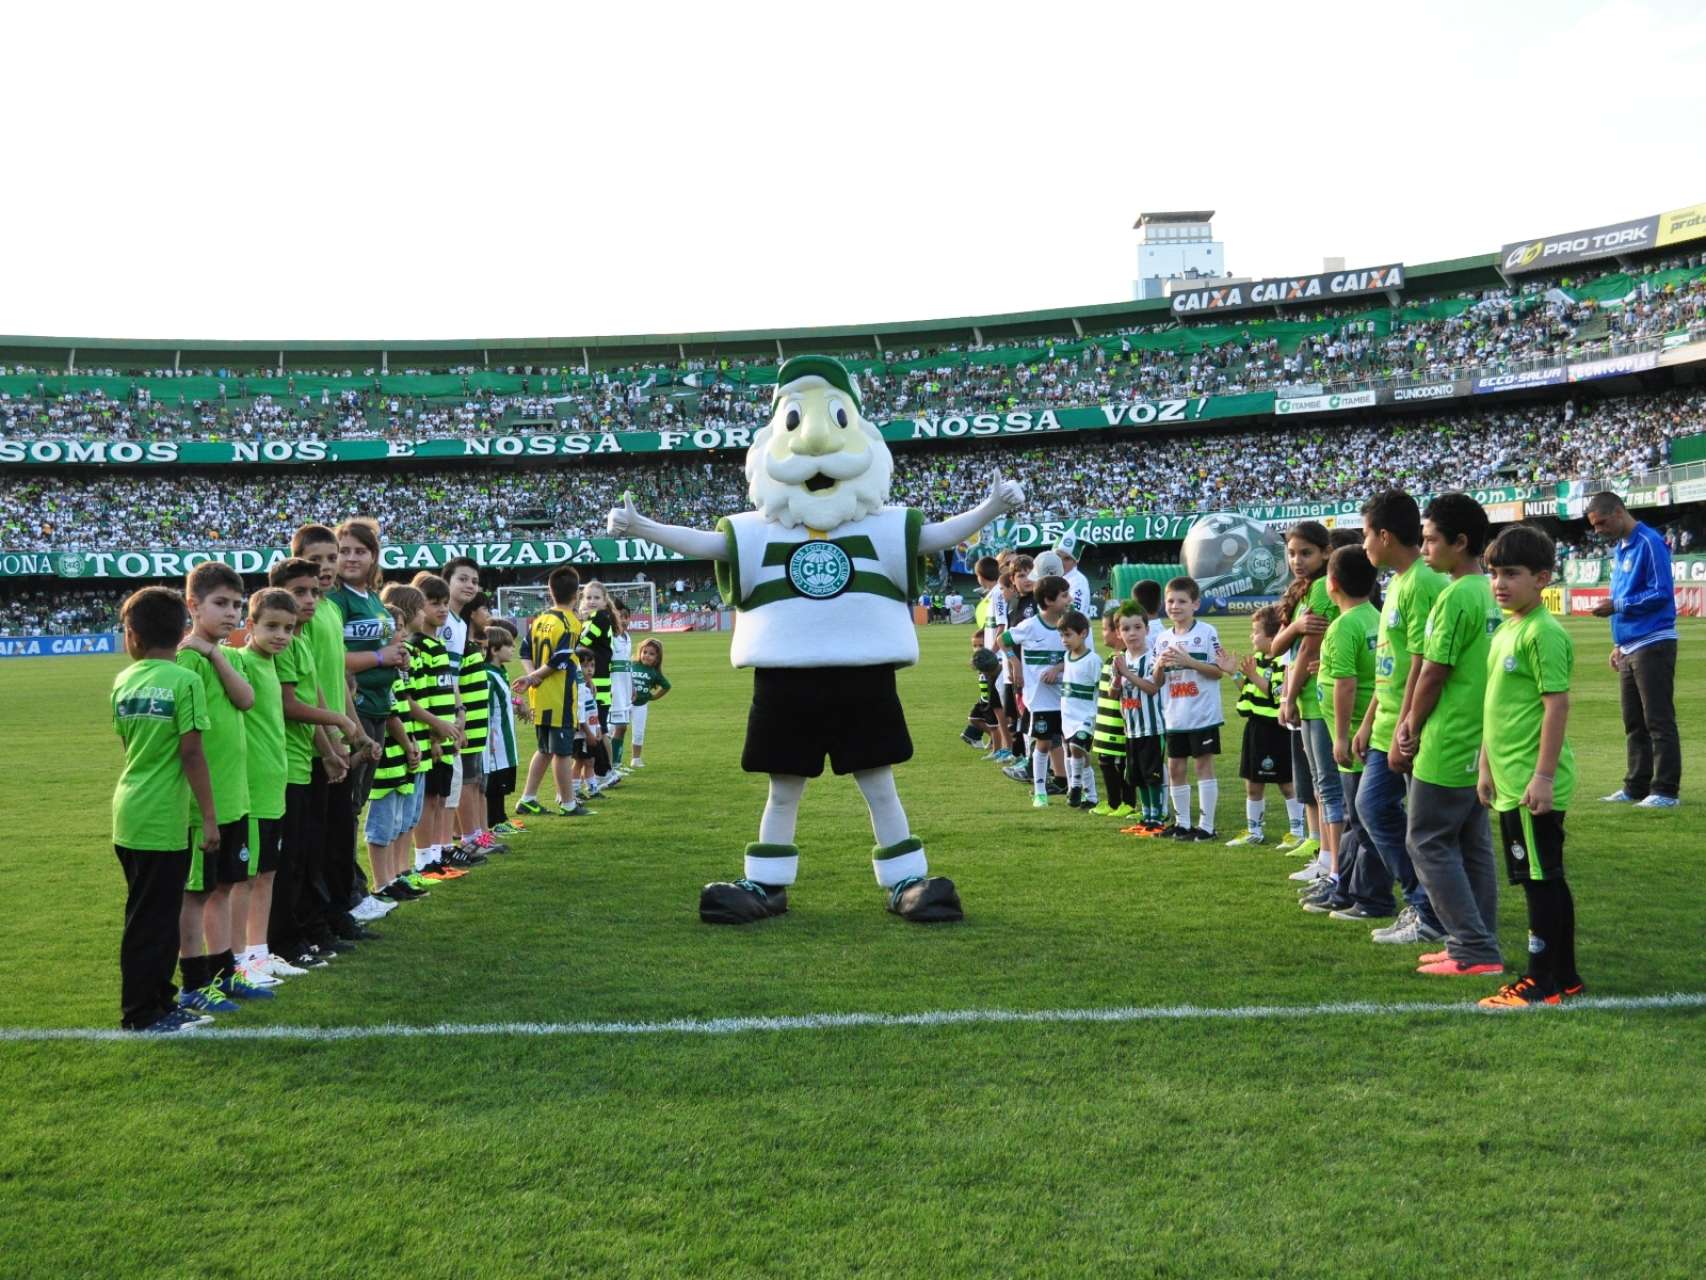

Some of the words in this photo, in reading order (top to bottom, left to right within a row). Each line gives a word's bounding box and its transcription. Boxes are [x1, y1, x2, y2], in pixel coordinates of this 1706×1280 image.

[1543, 238, 1589, 257] PRO
[1592, 225, 1648, 249] TORK
[1172, 287, 1242, 312] CAIXA
[1251, 278, 1321, 302] CAIXA
[1330, 267, 1401, 293] CAIXA
[912, 409, 1060, 438] NOSSA
[0, 440, 179, 463] SOMOS
[464, 432, 622, 456] NOSSA
[658, 428, 760, 450] FOR
[1080, 520, 1135, 543] desde
[1145, 514, 1199, 538] 1977
[0, 554, 54, 576] ONA
[615, 538, 684, 561] IM
[803, 561, 838, 576] CFC
[1204, 576, 1254, 599] CORITIBA
[352, 623, 380, 637] 1977
[51, 638, 109, 654] CAIXA
